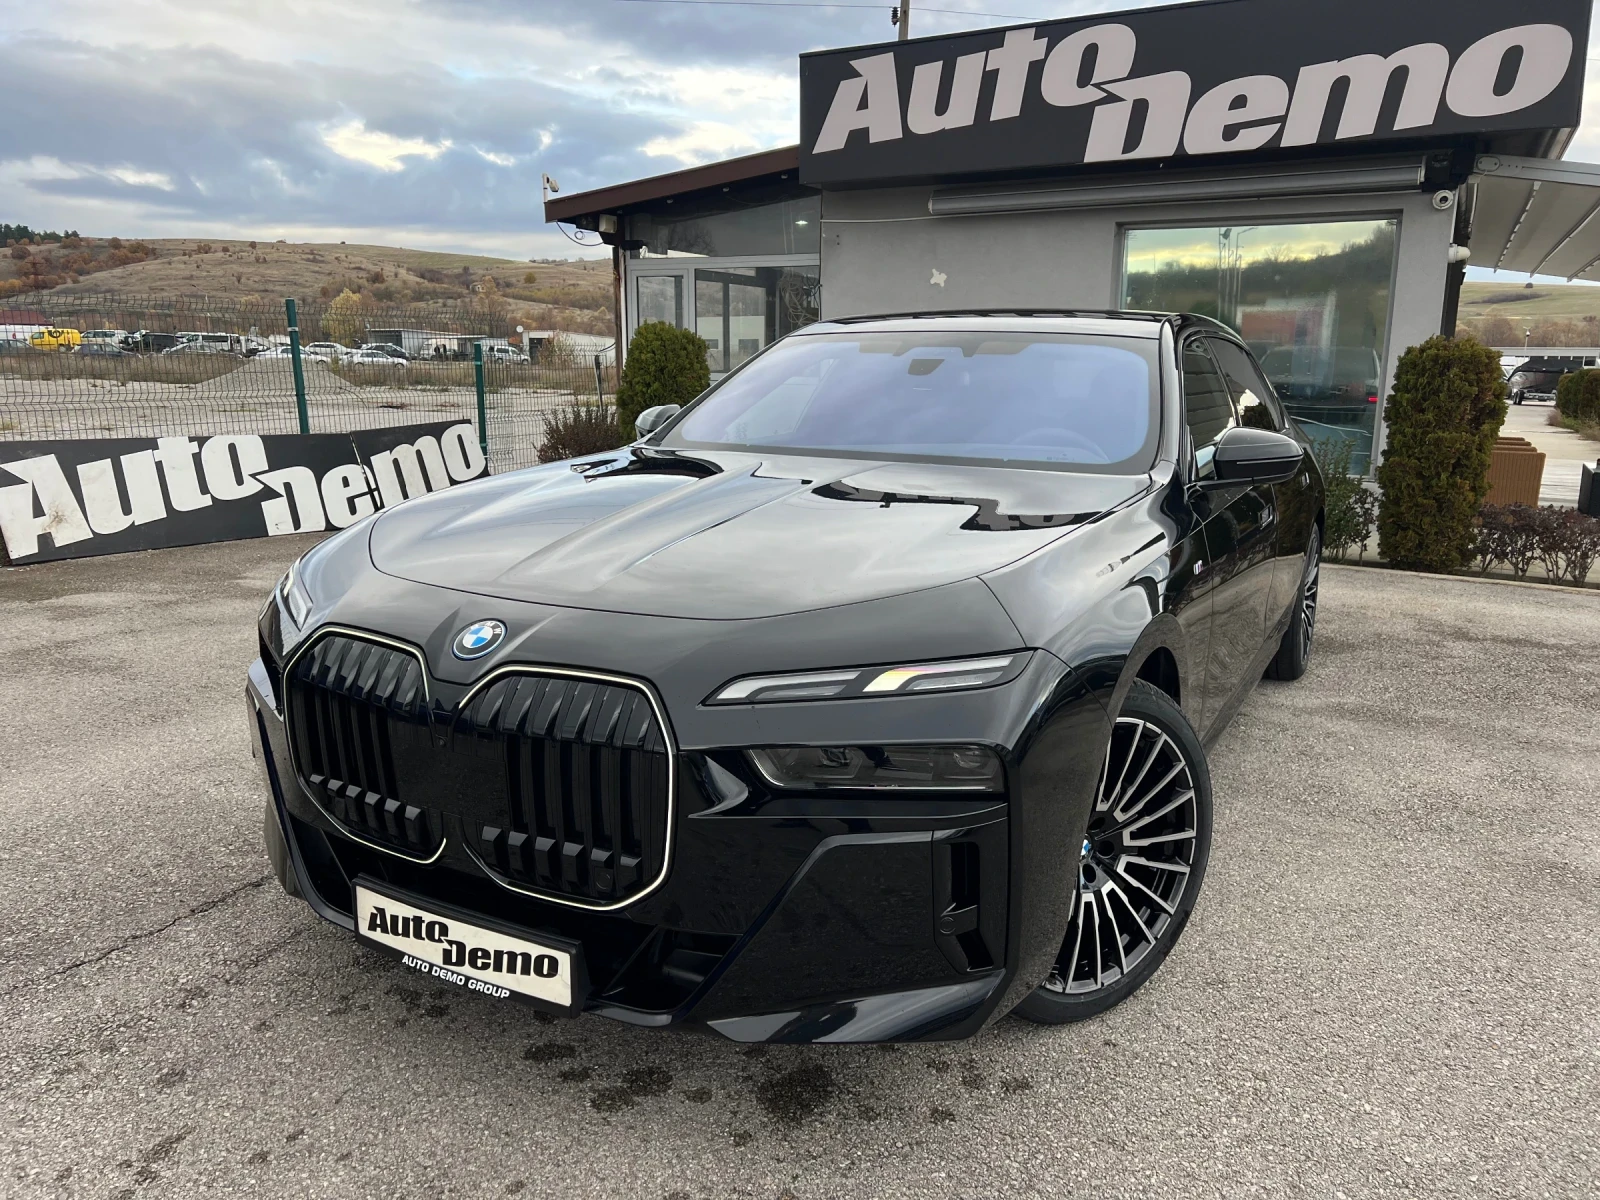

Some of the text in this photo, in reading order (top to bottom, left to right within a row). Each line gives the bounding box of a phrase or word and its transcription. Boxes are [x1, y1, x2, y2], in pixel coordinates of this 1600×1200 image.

[812, 23, 1573, 163] Auto Demo
[0, 423, 487, 559] Auto Demo
[367, 905, 559, 979] Auto Demo
[402, 955, 510, 999] AUTO DEMO GROUP
